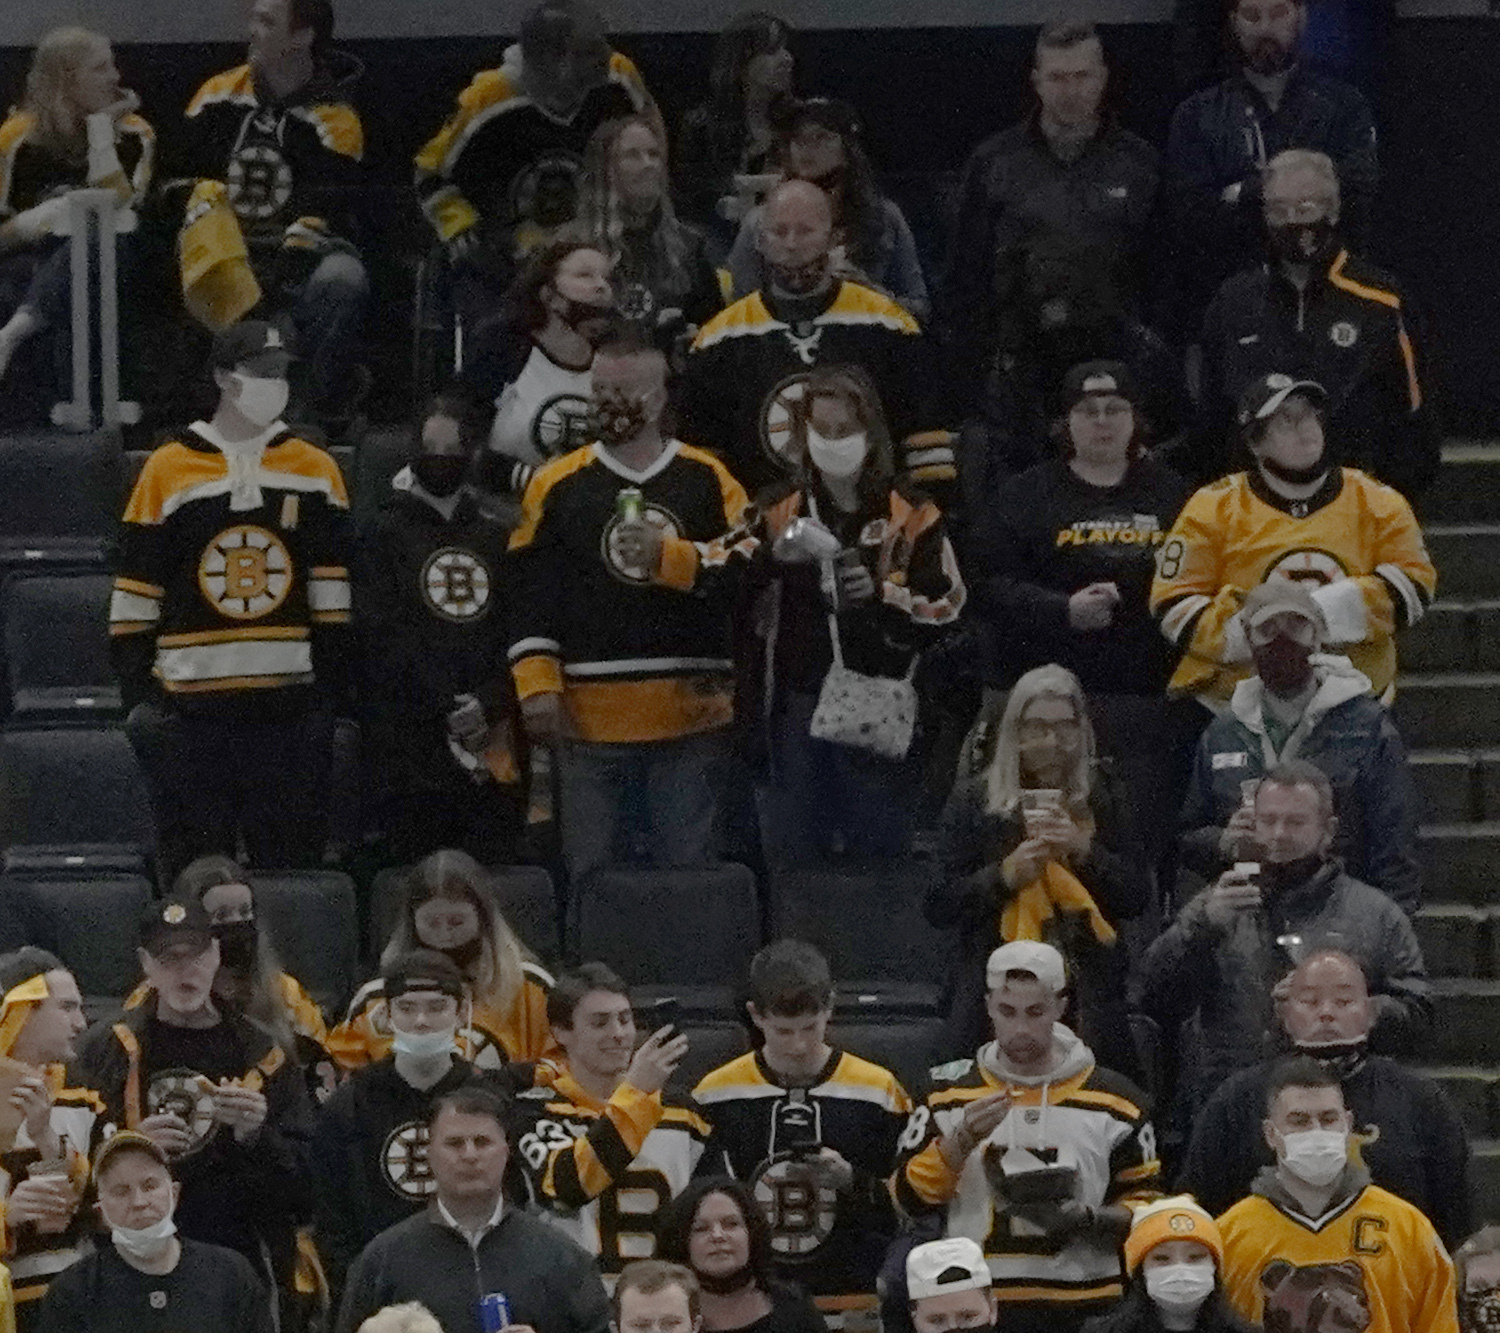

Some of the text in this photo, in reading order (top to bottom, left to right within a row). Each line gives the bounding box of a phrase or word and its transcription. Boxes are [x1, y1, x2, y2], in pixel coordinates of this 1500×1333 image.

[227, 551, 268, 598] B
[604, 1171, 672, 1261] B
[779, 1184, 812, 1231] B
[1355, 1215, 1387, 1255] C
